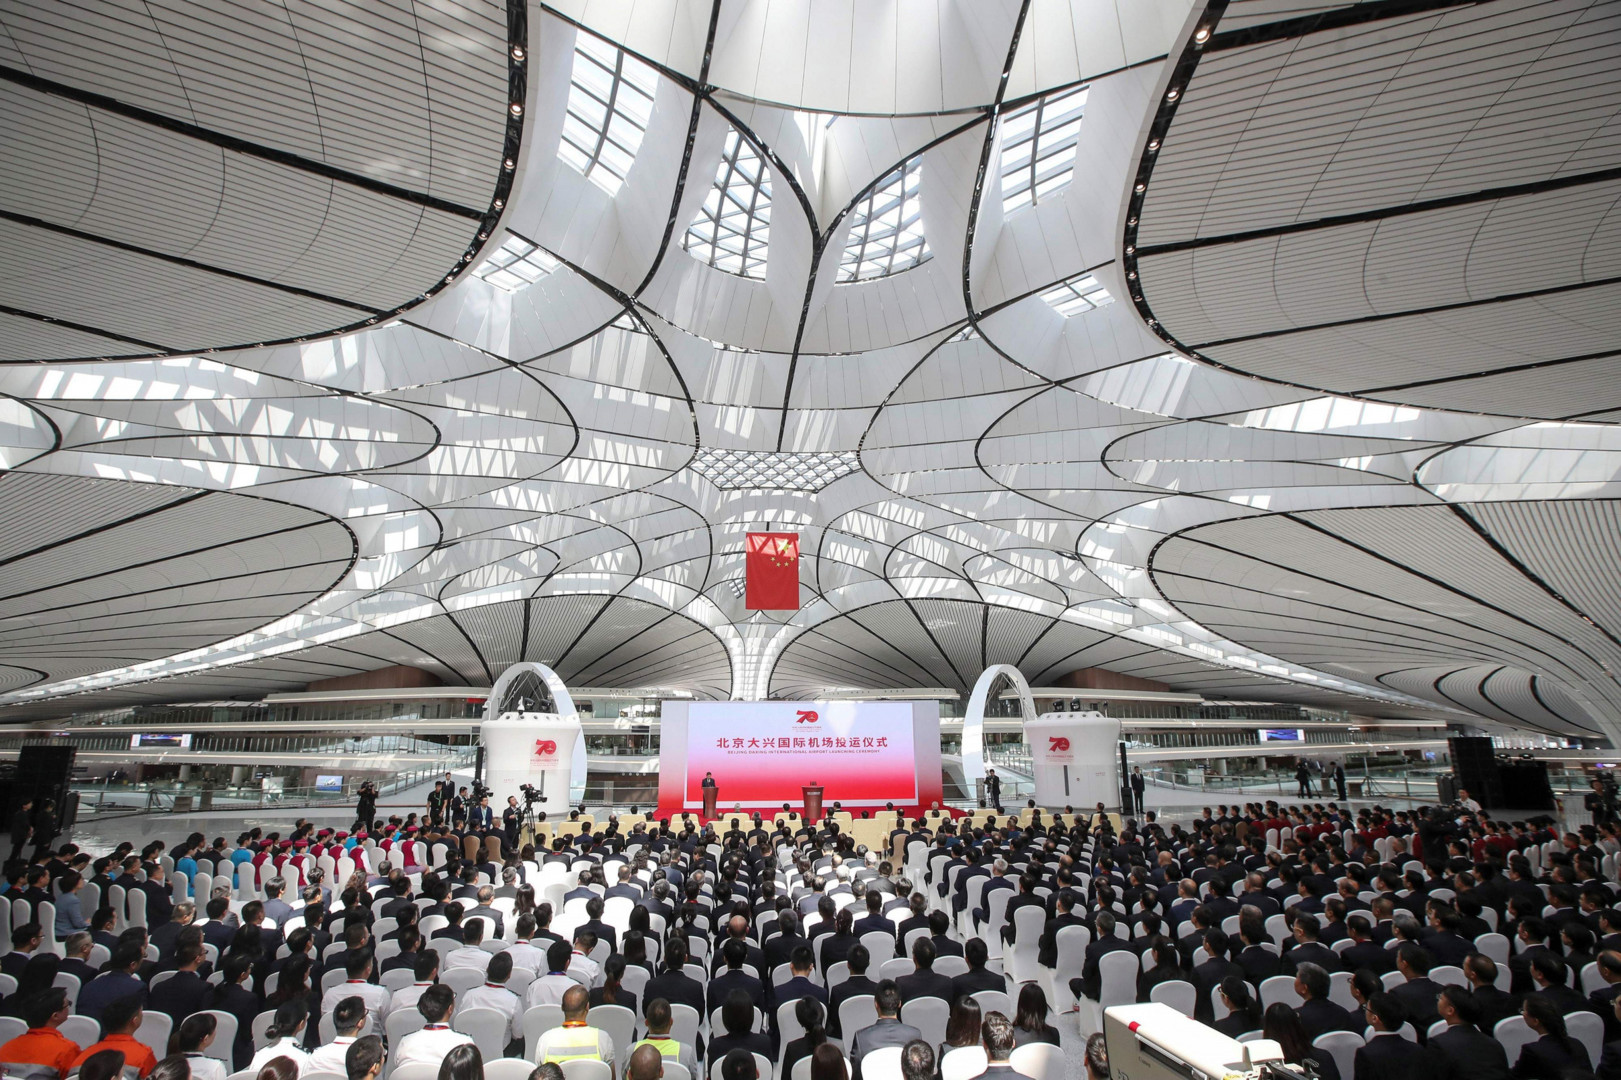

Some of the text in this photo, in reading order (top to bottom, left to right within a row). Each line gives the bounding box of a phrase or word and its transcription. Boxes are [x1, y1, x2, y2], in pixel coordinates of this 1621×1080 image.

[796, 710, 818, 724] 70
[534, 739, 557, 756] 70
[716, 737, 888, 748] 北京大兴国际机场投运仪式
[1049, 736, 1070, 752] 70
